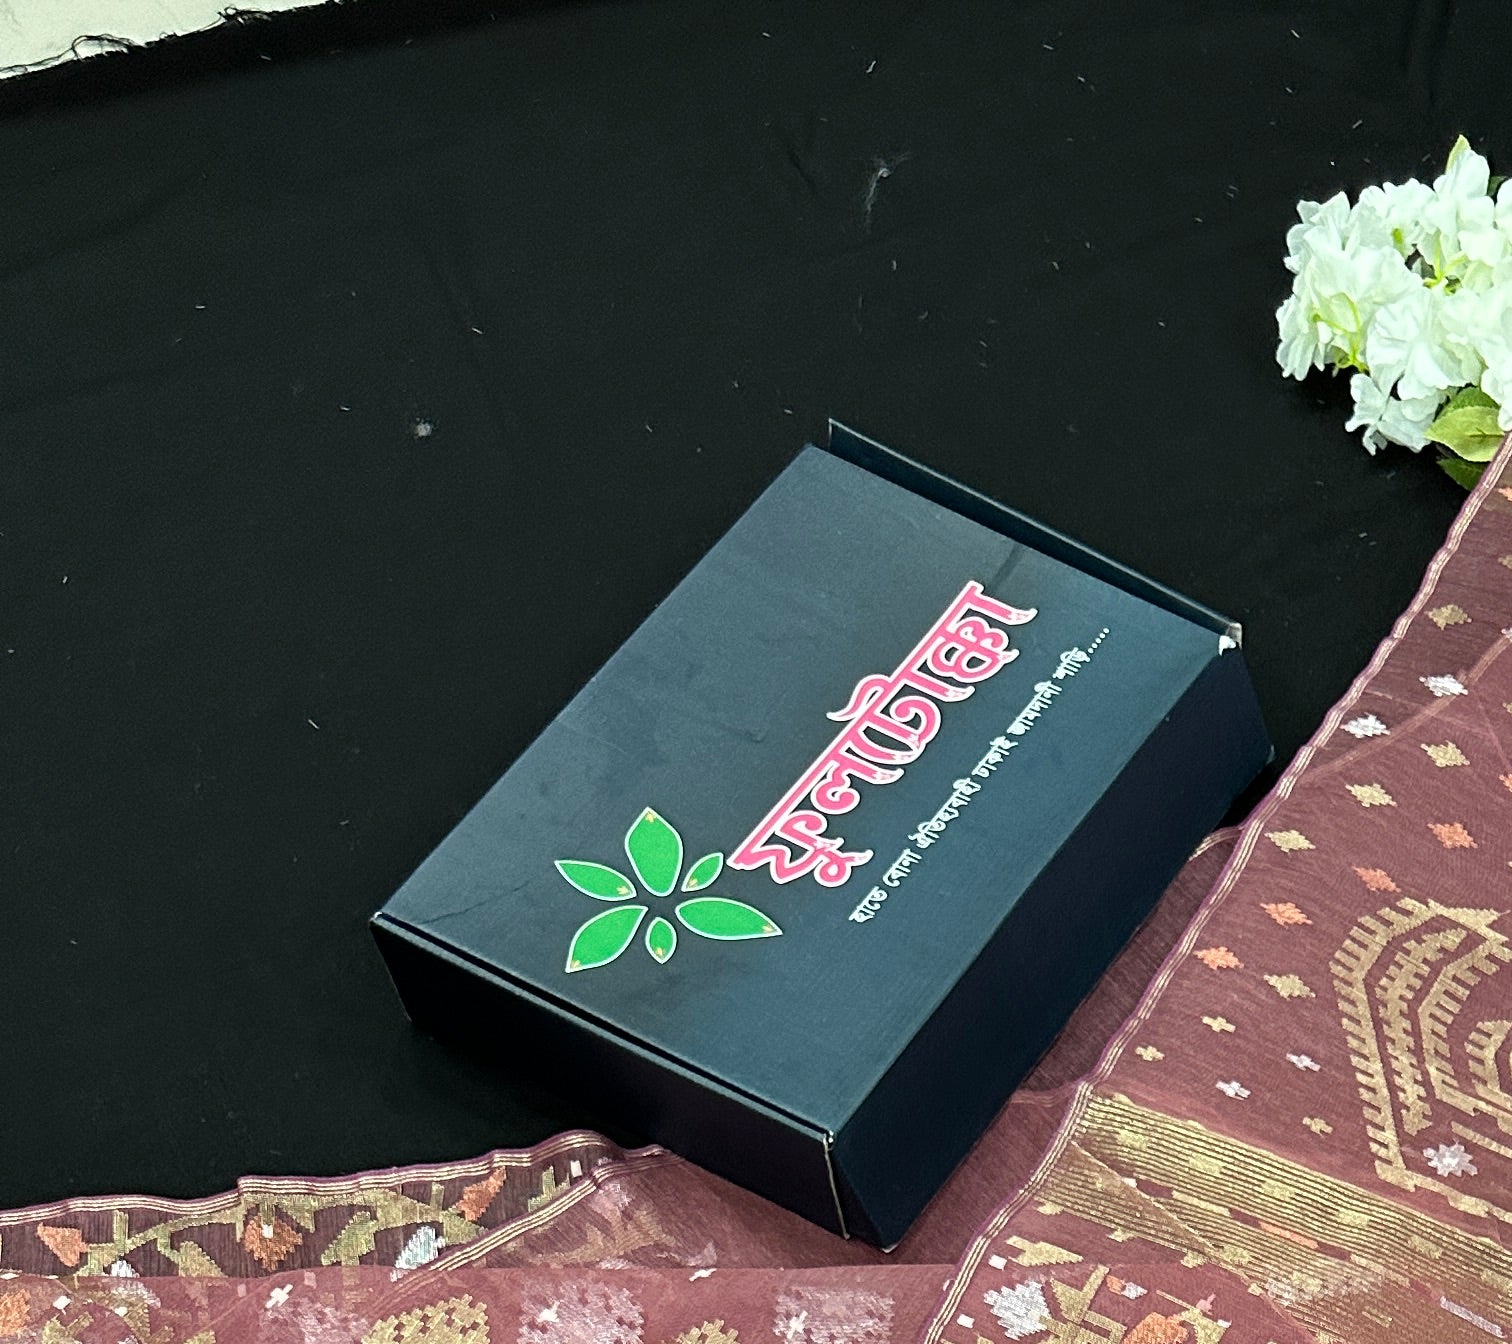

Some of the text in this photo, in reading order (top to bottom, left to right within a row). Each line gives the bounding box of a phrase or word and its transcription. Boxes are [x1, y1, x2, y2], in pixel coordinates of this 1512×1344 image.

[848, 886, 888, 923] হাতে
[882, 848, 923, 887] বোনা
[907, 777, 982, 849] ঐতিহ্যবাহী
[971, 735, 1019, 778] ঢাকাই
[1006, 680, 1063, 736] জামদানী
